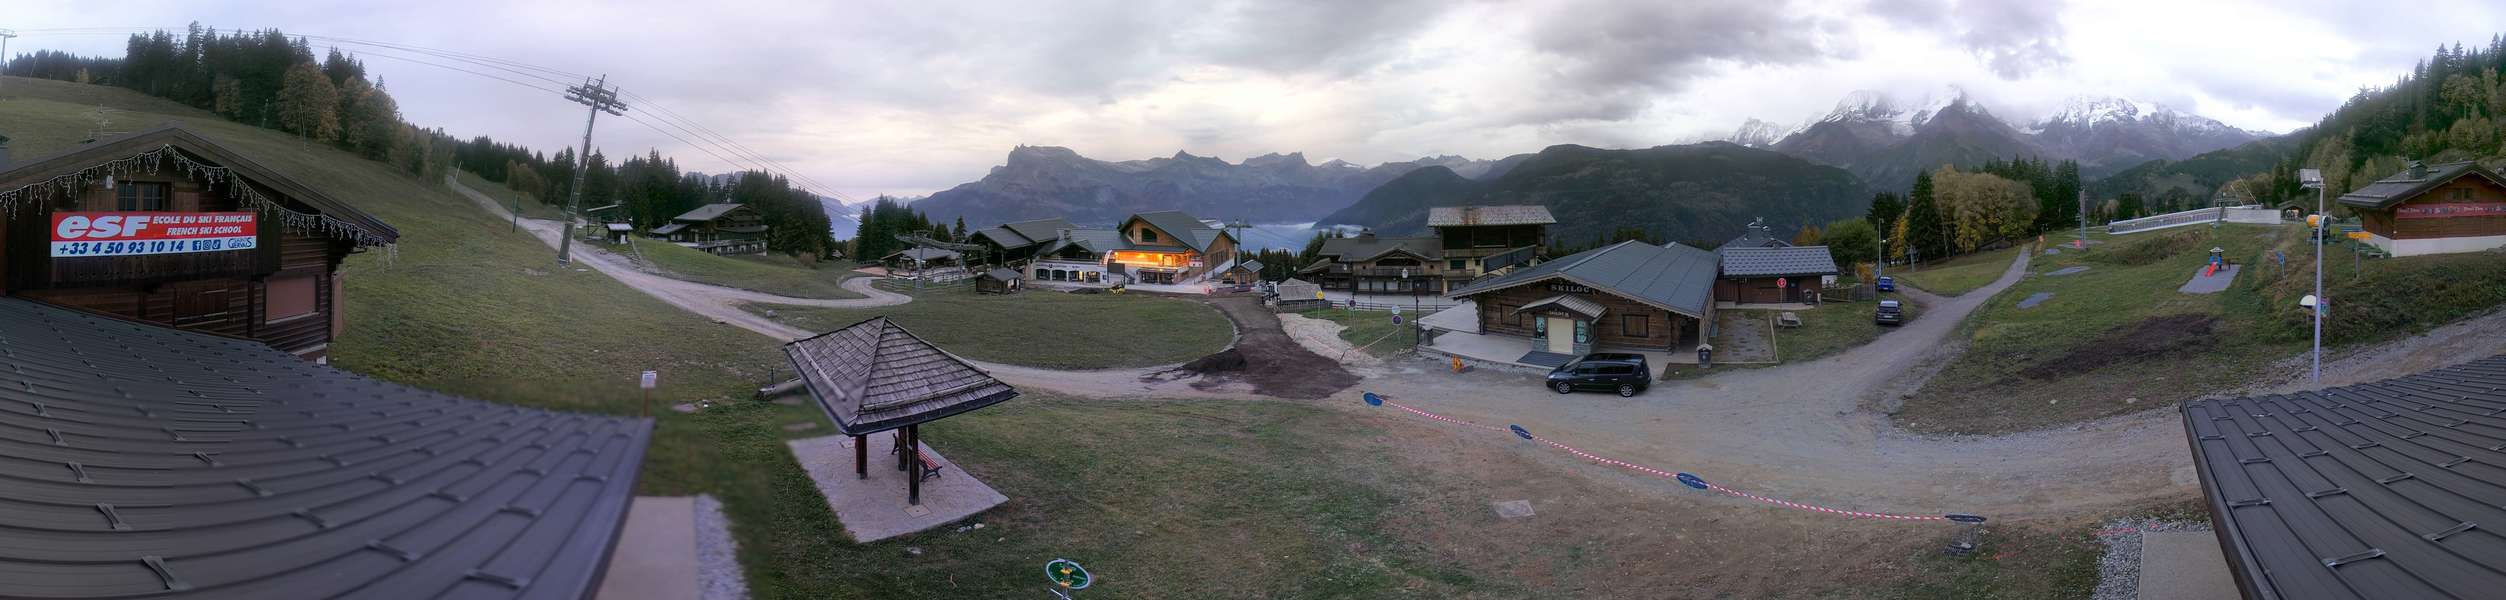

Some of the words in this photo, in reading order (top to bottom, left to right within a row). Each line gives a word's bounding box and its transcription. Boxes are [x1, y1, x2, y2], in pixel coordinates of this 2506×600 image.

[183, 215, 197, 224] DU
[198, 215, 212, 223] SKI
[166, 227, 198, 236] FRENCH
[199, 226, 212, 235] SKI
[213, 225, 242, 234] SCHOOL
[60, 242, 88, 254] +33
[92, 242, 102, 254] 4
[104, 241, 124, 254] 50
[128, 241, 145, 253] 93
[150, 241, 165, 252] 10
[169, 240, 185, 252] 14
